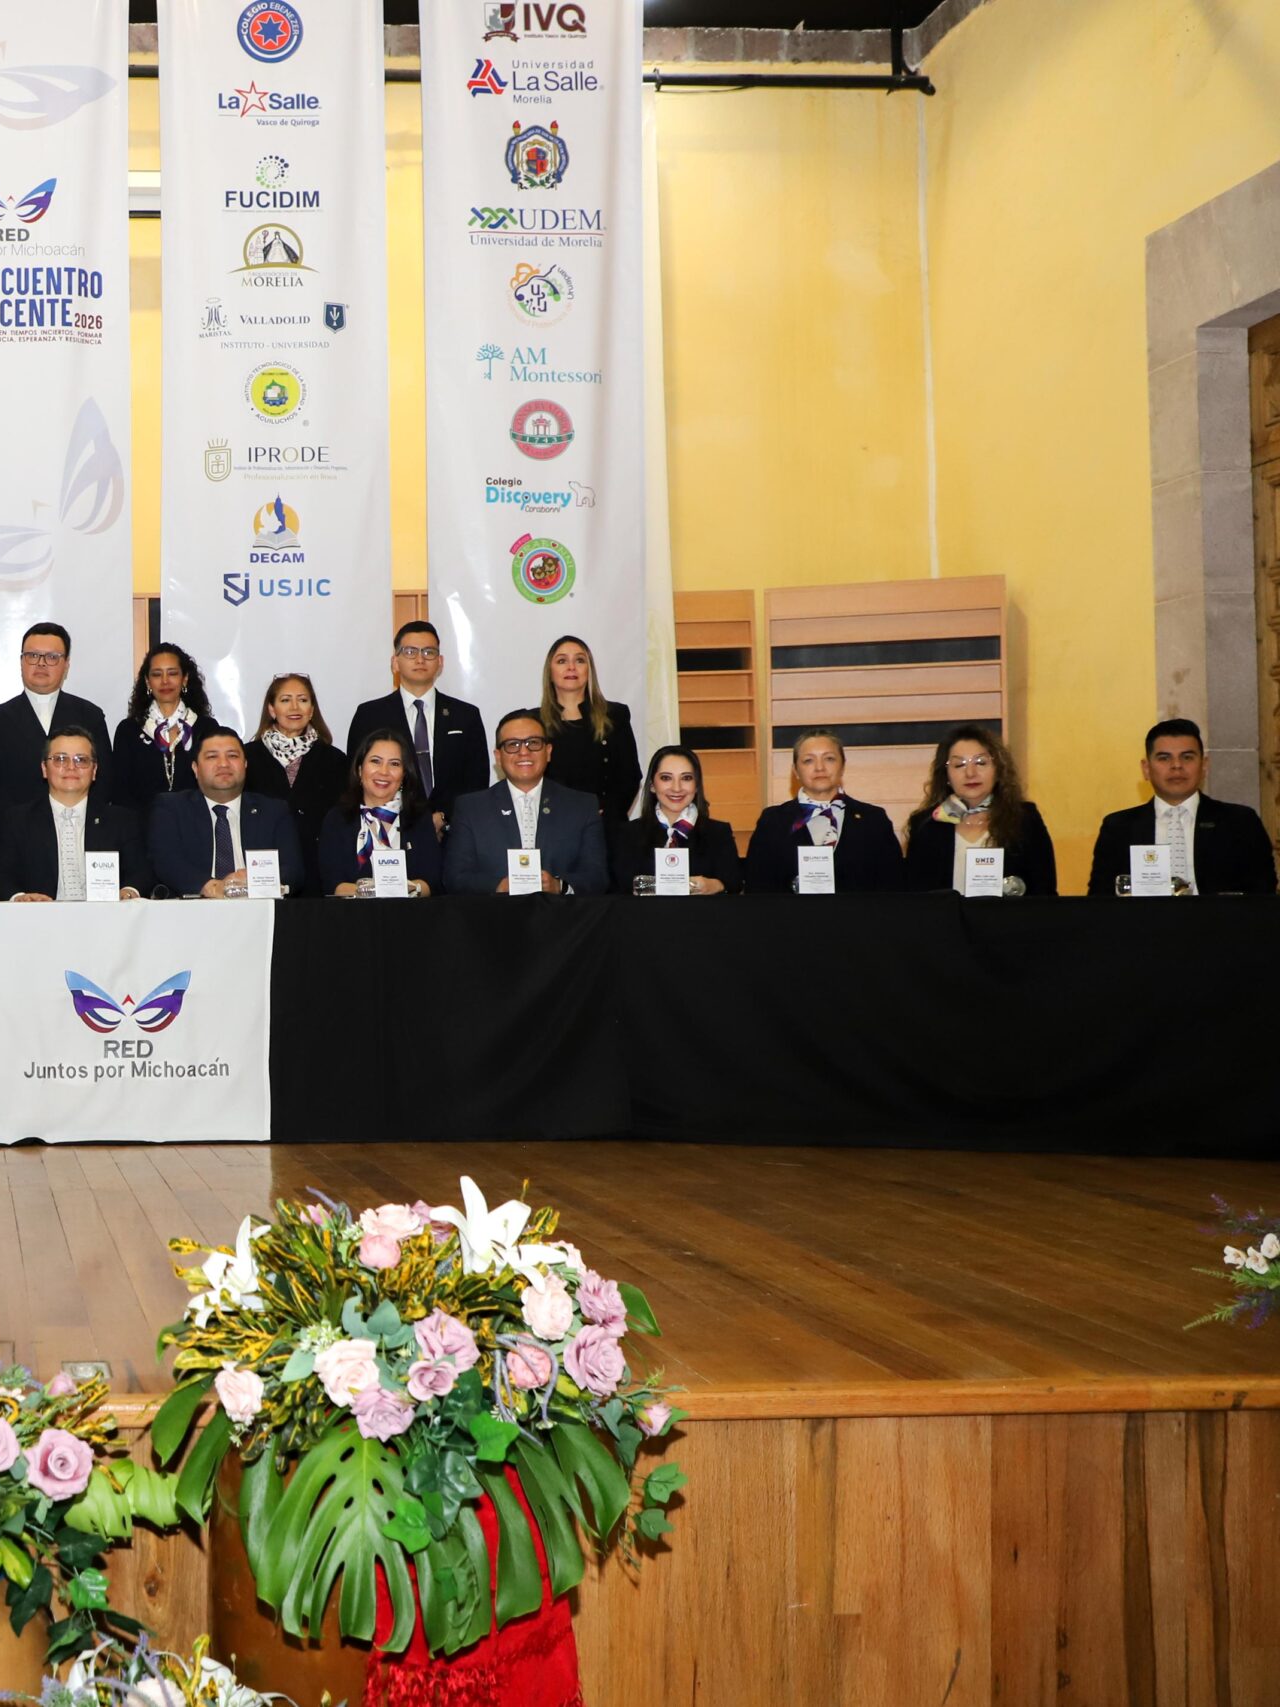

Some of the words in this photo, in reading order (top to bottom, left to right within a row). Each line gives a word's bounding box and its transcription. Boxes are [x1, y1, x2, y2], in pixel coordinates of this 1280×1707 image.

[241, 2, 268, 35] COLEGIO
[269, 2, 300, 35] EBENEZER
[523, 3, 587, 33] IVQ
[512, 60, 594, 69] Universidad
[512, 71, 540, 91] La
[544, 71, 598, 91] Salle
[218, 93, 240, 109] La
[268, 93, 320, 110] Salle
[513, 95, 552, 104] Morelia
[256, 118, 278, 126] Vasco
[279, 118, 288, 126] de
[290, 118, 320, 127] Quiroga
[225, 191, 320, 208] FUCIDIM
[518, 208, 603, 230] UDEM
[10, 242, 86, 257] Michoacán
[470, 235, 538, 247] Universidad
[541, 236, 555, 247] de
[558, 236, 603, 247] Morelia
[241, 276, 304, 287] MORELIA
[74, 312, 103, 330] 2026
[240, 314, 311, 325] VALLADOLID
[65, 336, 102, 345] RESILIENCIA
[271, 341, 330, 349] UNIVERSIDAD
[510, 347, 546, 365] AM
[248, 446, 330, 463] IPRODE
[486, 477, 522, 487] Colegio
[486, 486, 572, 510] Discovery
[250, 552, 305, 563] DECAM
[259, 578, 331, 597] USJIC
[103, 1039, 154, 1059] RED
[23, 1061, 88, 1079] Juntos
[94, 1064, 125, 1082] por
[131, 1057, 230, 1079] Michoacán
